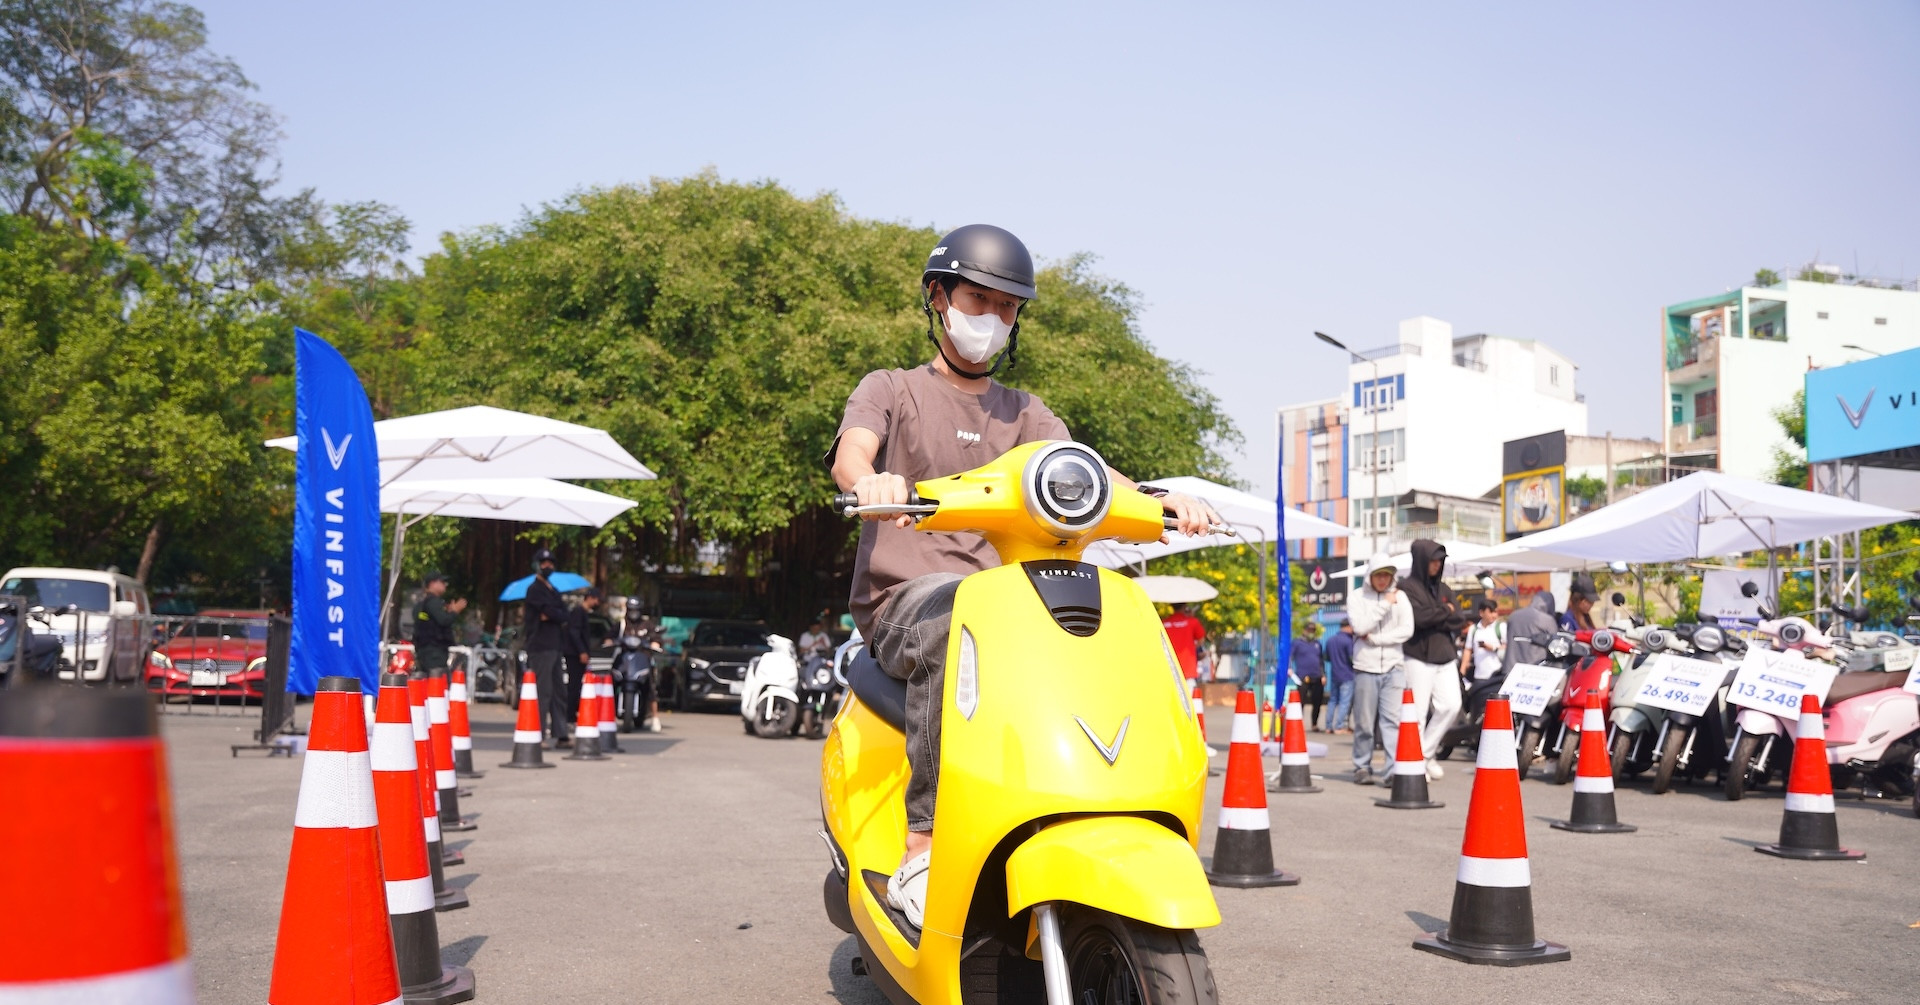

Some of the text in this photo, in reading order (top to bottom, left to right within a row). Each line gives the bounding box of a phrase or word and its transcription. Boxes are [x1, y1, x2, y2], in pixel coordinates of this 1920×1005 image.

[957, 430, 980, 442] PAPA
[326, 487, 344, 648] VINFAST
[1039, 570, 1092, 579] VINFAST
[1642, 684, 1690, 703] 26.496
[1738, 682, 1798, 708] 13.248
